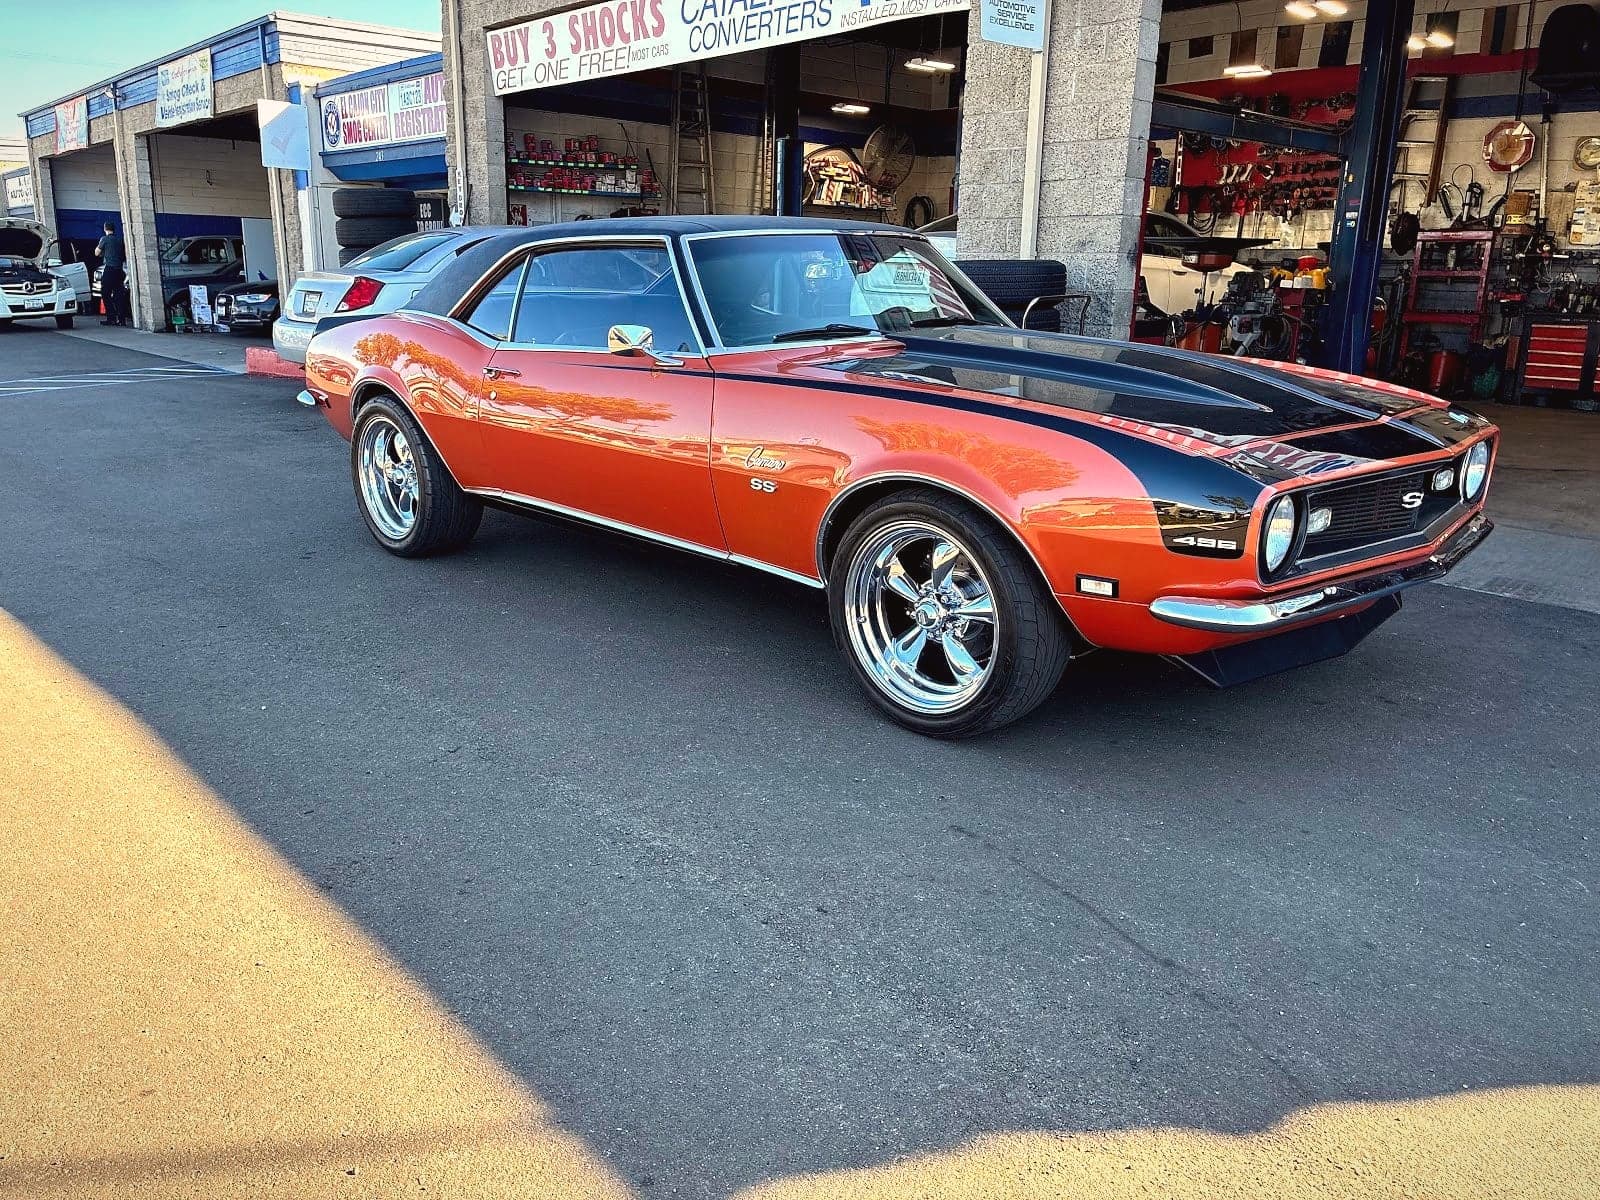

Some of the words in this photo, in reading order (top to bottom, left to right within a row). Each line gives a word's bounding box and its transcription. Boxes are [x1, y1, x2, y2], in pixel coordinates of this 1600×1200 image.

[840, 3, 898, 28] INSTALLED
[900, 0, 929, 15] MOST
[989, 0, 1036, 14] AUTOMOTIVE
[997, 9, 1027, 21] SERVICE
[490, 27, 530, 69] BUY
[542, 21, 557, 59] 3
[568, 0, 666, 54] SHOCKS
[689, 0, 833, 53] CONVERTERS
[990, 16, 1035, 31] EXCELLENCE
[496, 66, 527, 90] GET
[534, 58, 570, 84] ONE
[578, 45, 633, 77] FREE!
[631, 48, 649, 62] MOST
[652, 44, 669, 58] CARS
[340, 96, 348, 119] EL
[370, 88, 386, 114] CITY
[424, 74, 445, 104] AUT
[343, 120, 363, 145] SMOG
[363, 116, 388, 142] CENTER
[394, 105, 446, 138] REGISTRAT
[750, 477, 777, 493] SS
